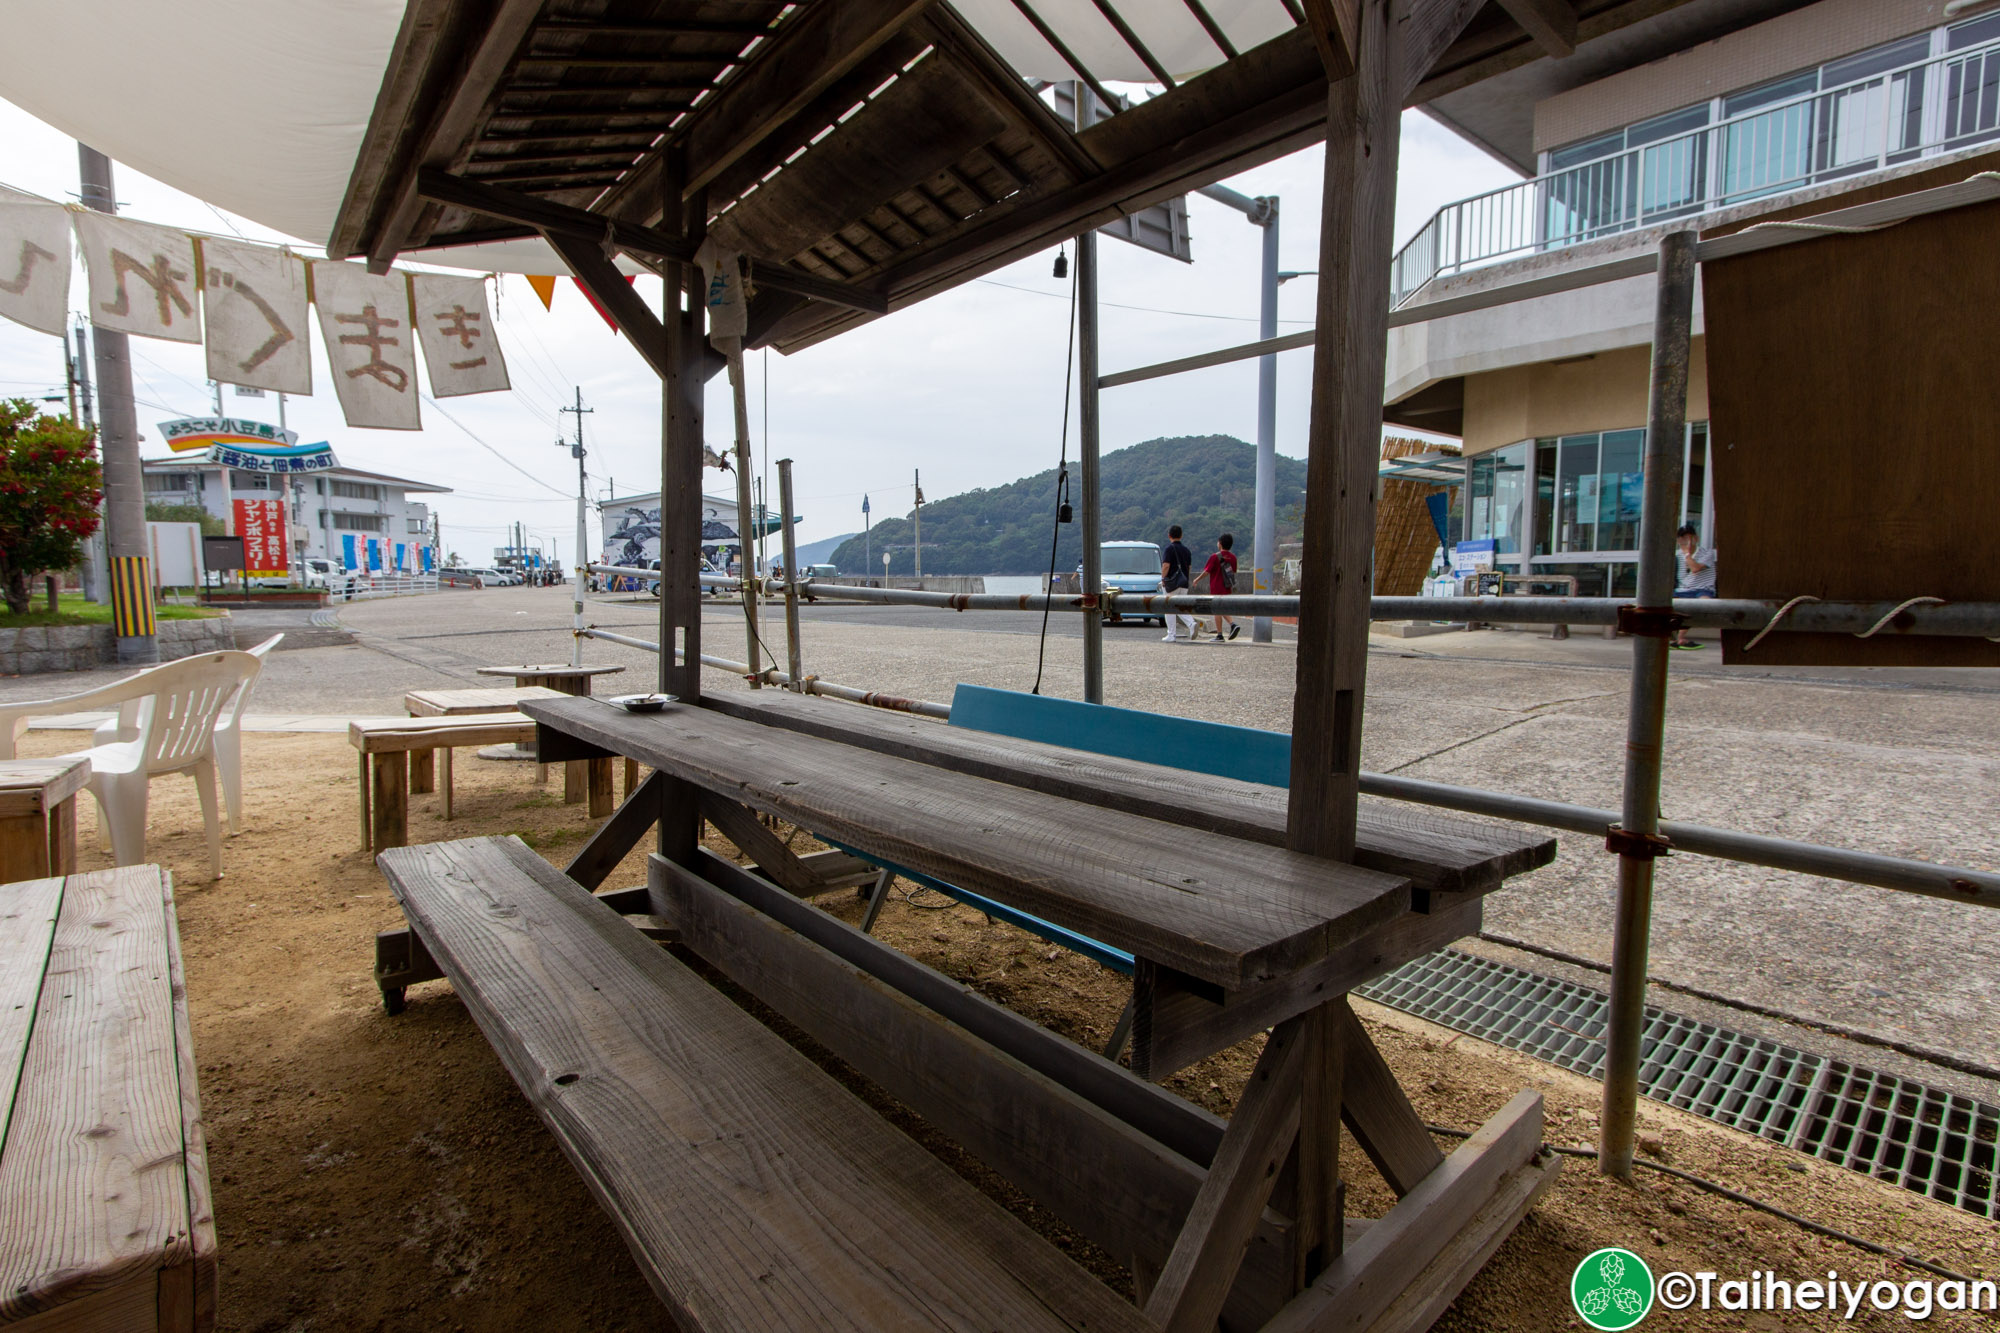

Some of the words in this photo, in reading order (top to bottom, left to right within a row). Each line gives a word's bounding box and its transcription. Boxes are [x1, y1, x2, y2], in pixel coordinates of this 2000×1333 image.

[168, 418, 288, 442] ようこそ小豆島へ
[222, 448, 334, 473] 醤油と佃煮の町
[243, 500, 263, 569] ジャンボフェリー
